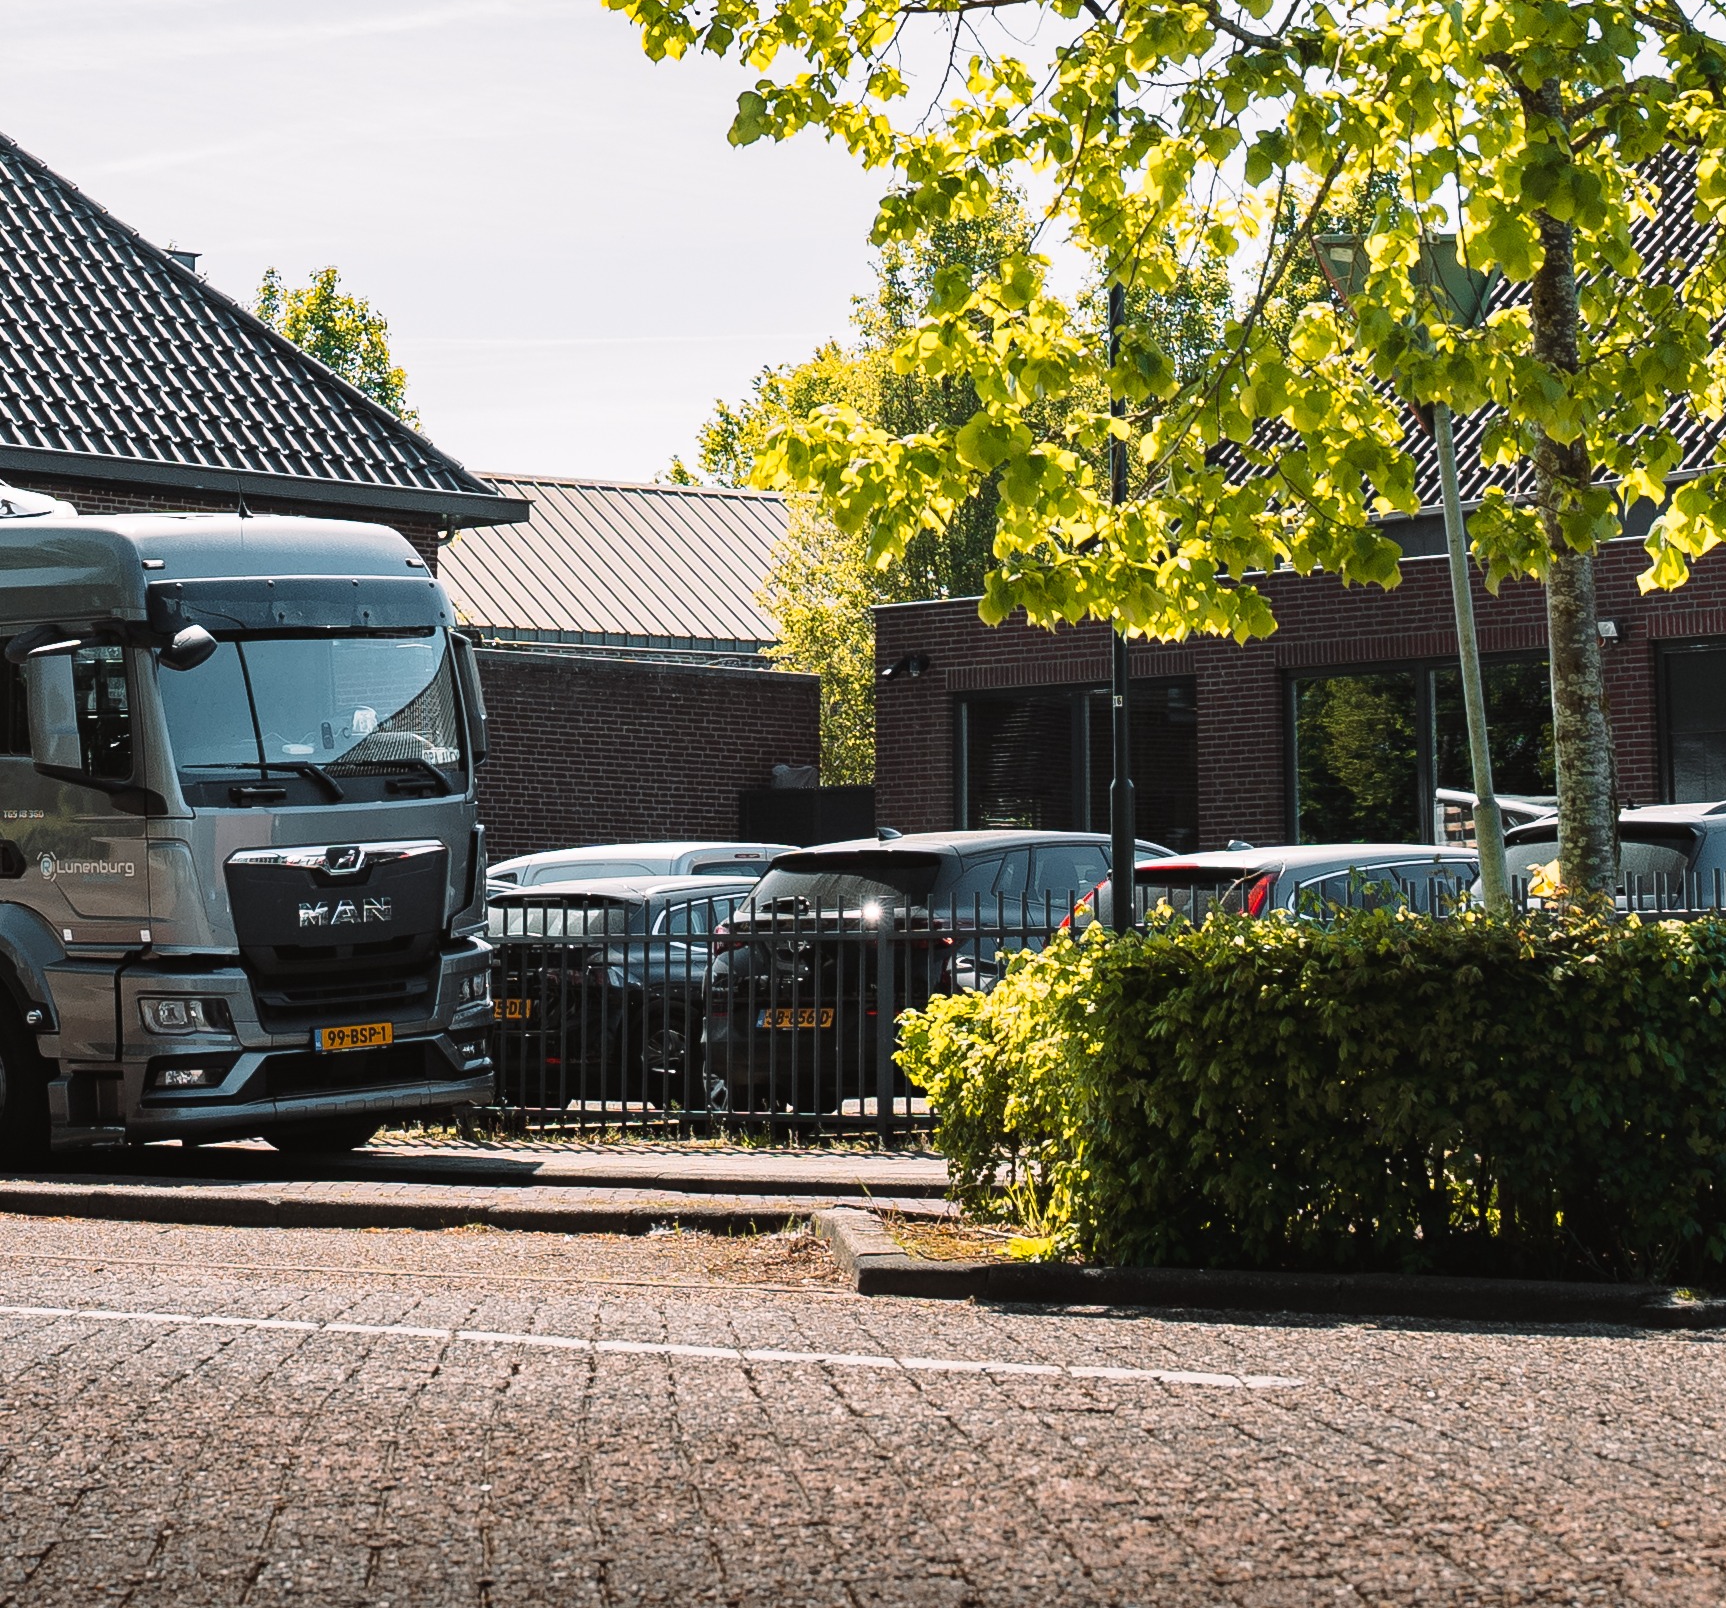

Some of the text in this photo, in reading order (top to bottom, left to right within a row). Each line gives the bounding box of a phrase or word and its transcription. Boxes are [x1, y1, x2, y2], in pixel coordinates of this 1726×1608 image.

[56, 859, 135, 877] Lunenburg
[298, 897, 393, 927] MAN
[327, 1024, 388, 1047] 99-BSP-1
